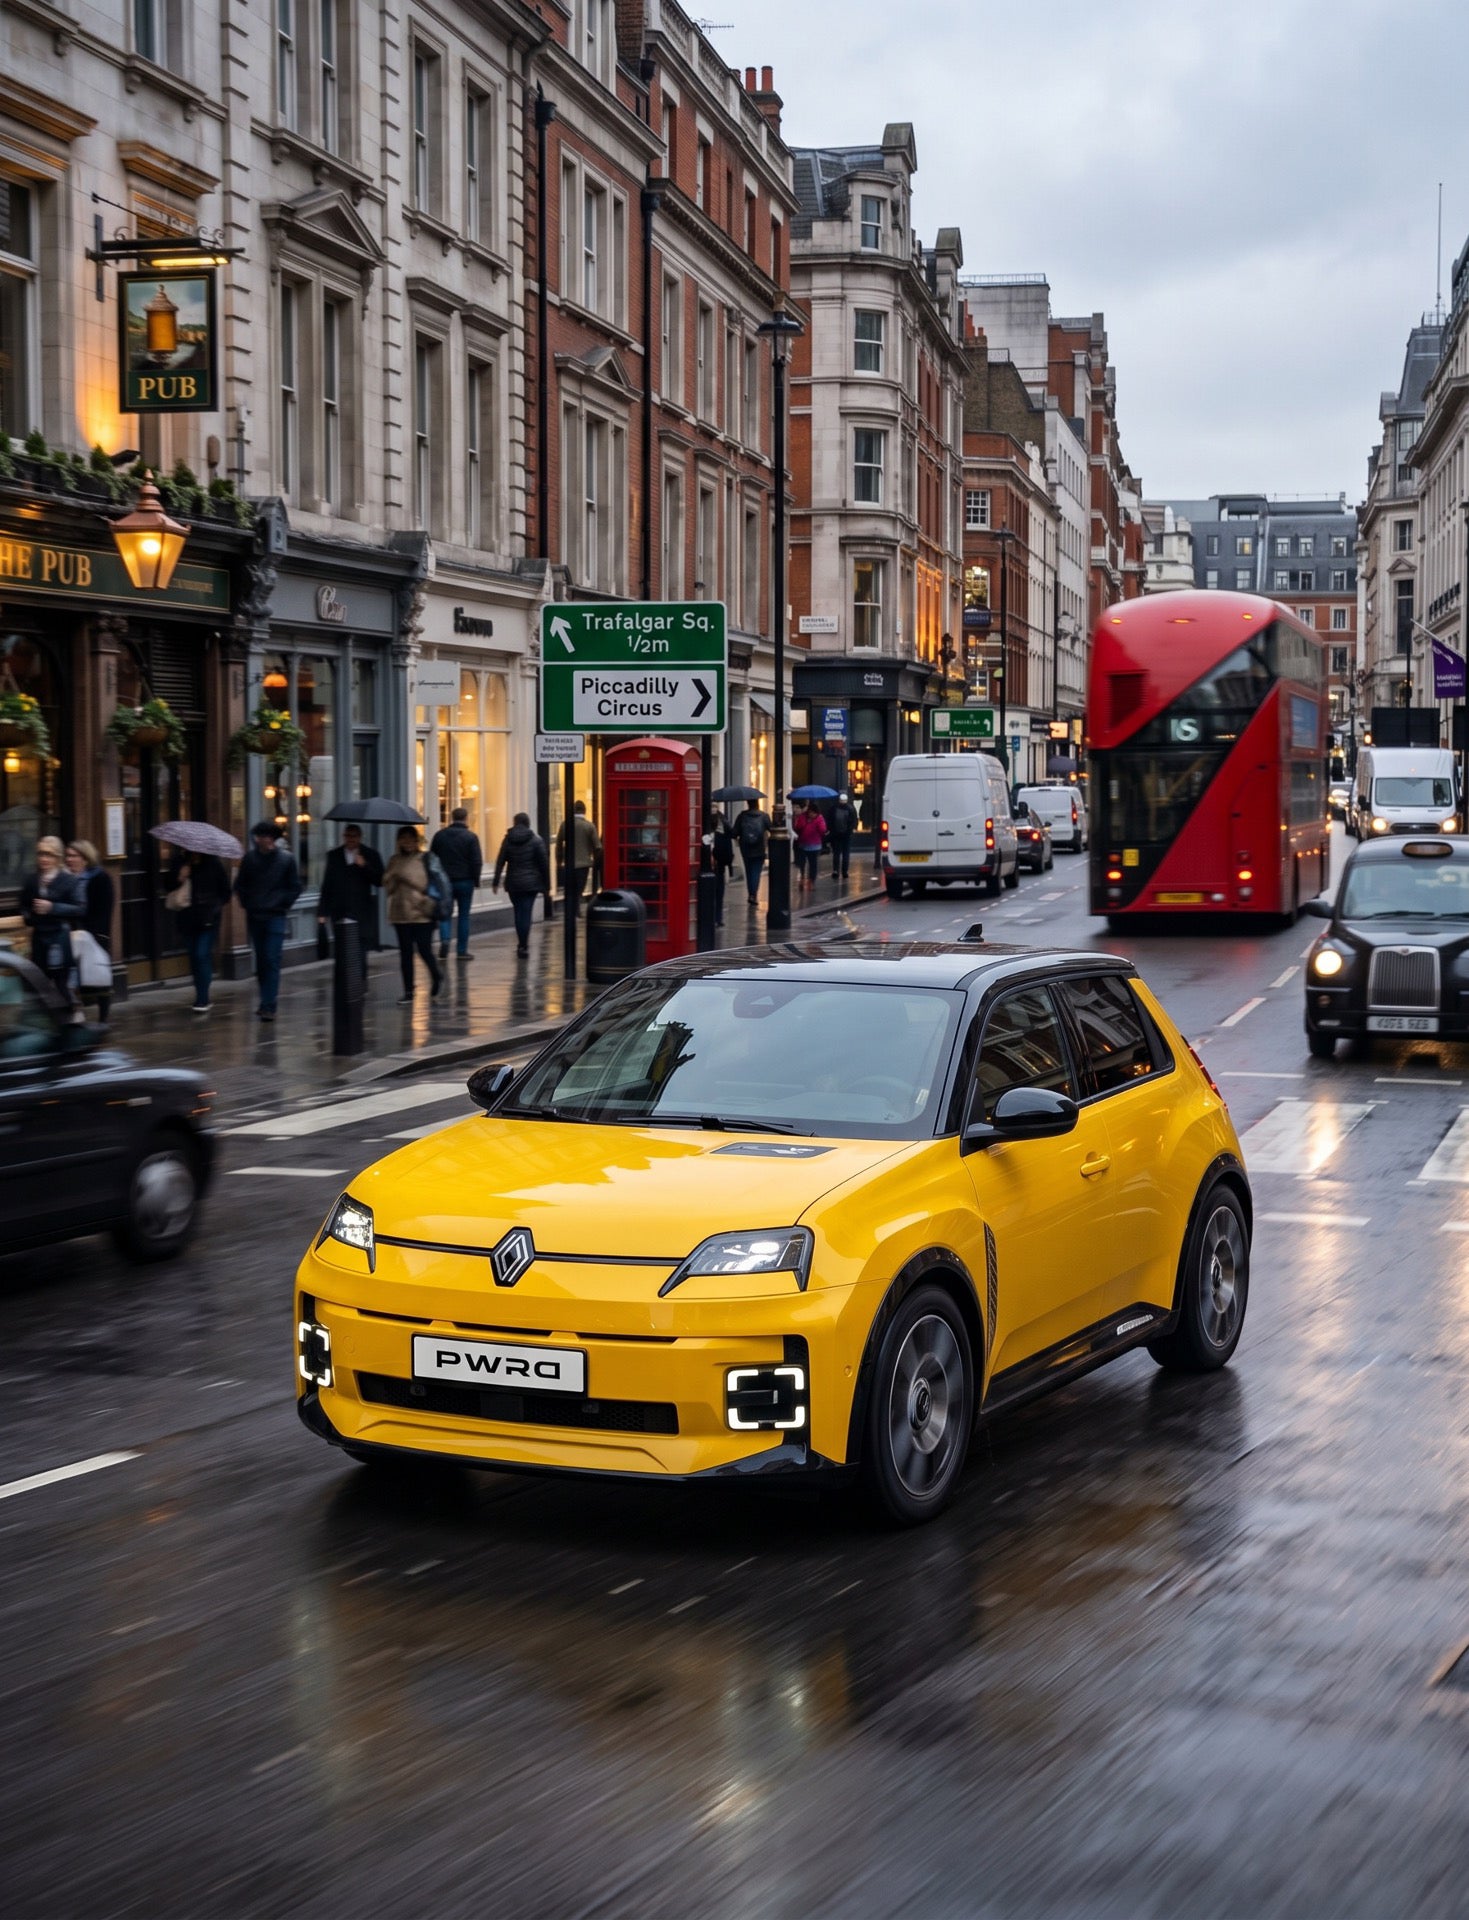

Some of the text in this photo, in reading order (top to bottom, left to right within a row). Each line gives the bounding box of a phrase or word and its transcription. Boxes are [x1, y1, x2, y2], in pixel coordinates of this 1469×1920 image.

[138, 376, 197, 399] PUB
[0, 541, 92, 586] HE PUB
[582, 612, 715, 633] Trafalgar Sq.
[581, 677, 679, 697] Piccadilly
[597, 699, 663, 716] Circus
